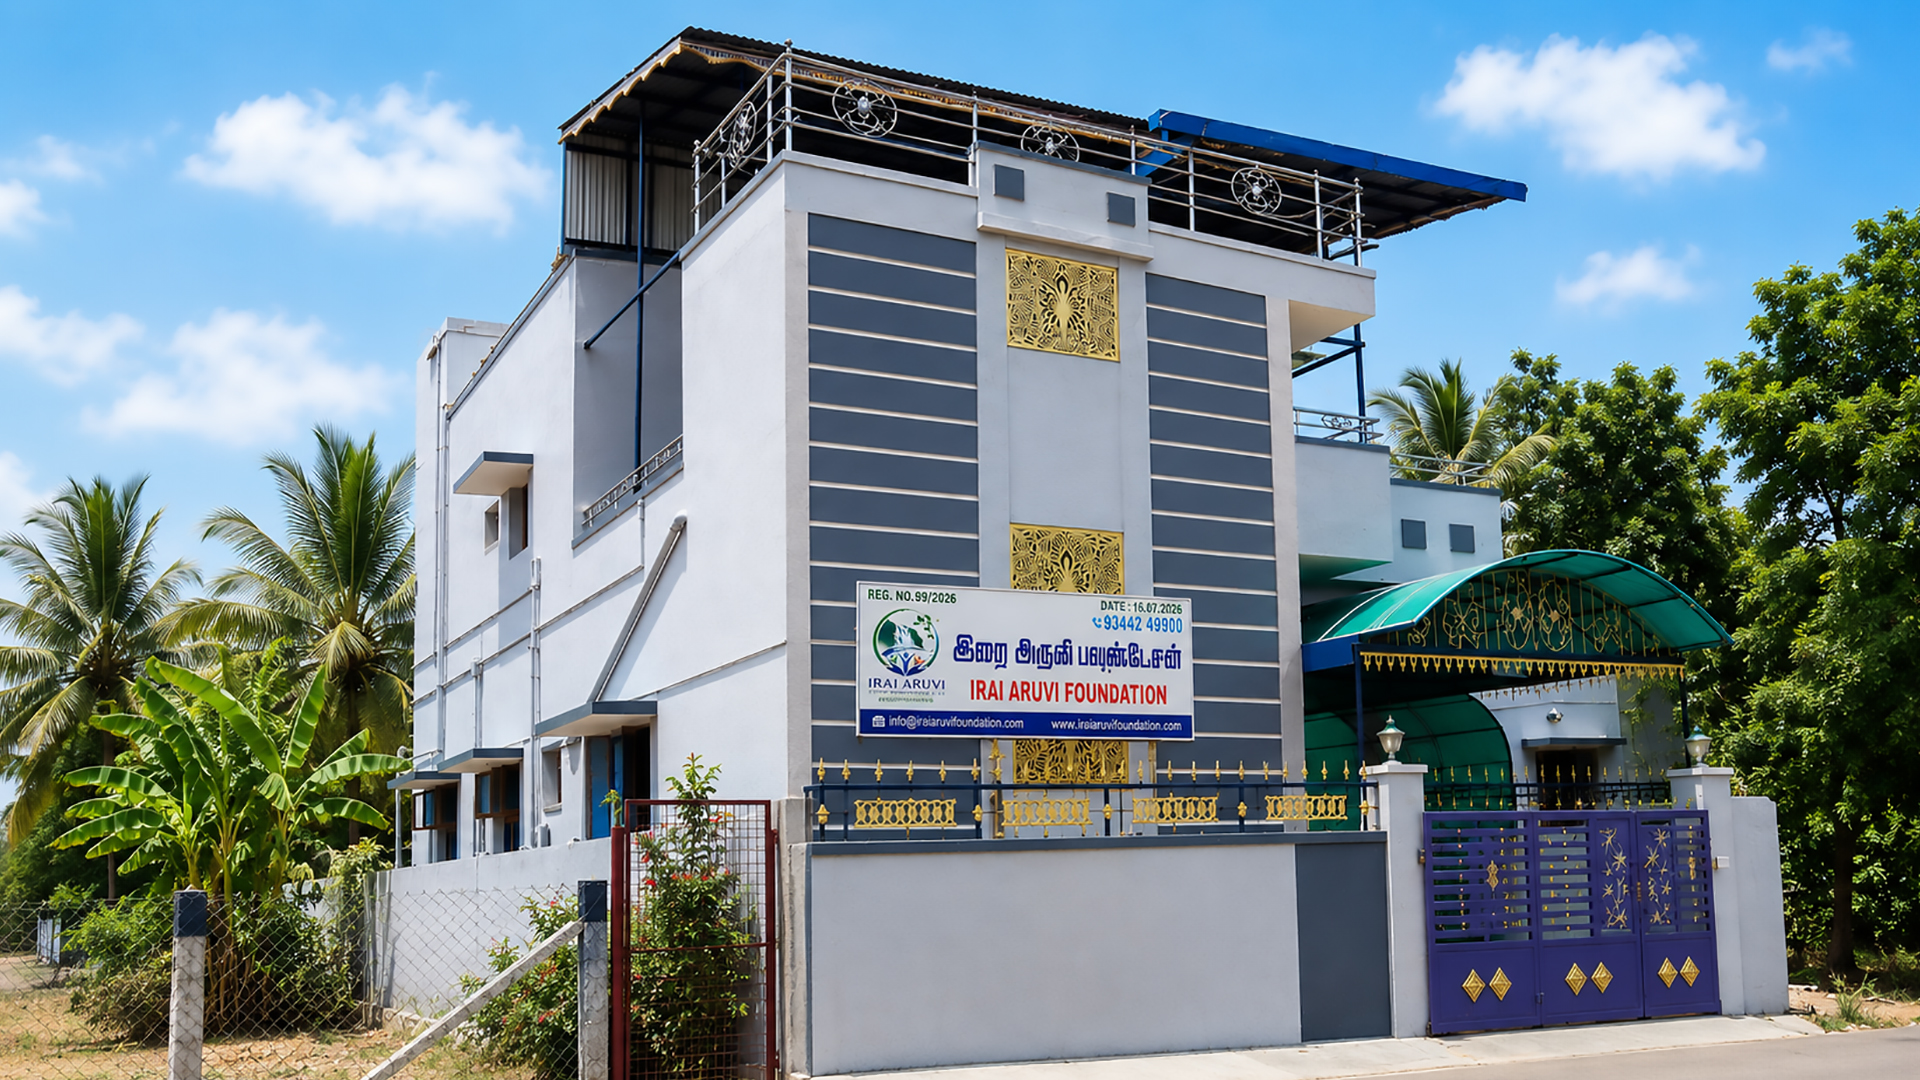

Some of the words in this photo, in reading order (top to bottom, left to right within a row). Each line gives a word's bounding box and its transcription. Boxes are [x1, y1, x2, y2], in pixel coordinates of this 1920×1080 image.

[867, 588, 893, 601] REG.
[1103, 614, 1143, 632] 93442
[1146, 616, 1183, 633] 49900
[868, 677, 898, 689] IRAI
[902, 678, 945, 690] ARUVI
[970, 679, 1004, 701] IRAI
[1008, 680, 1059, 702] ARUVI
[1065, 682, 1167, 705] FOUNDATION
